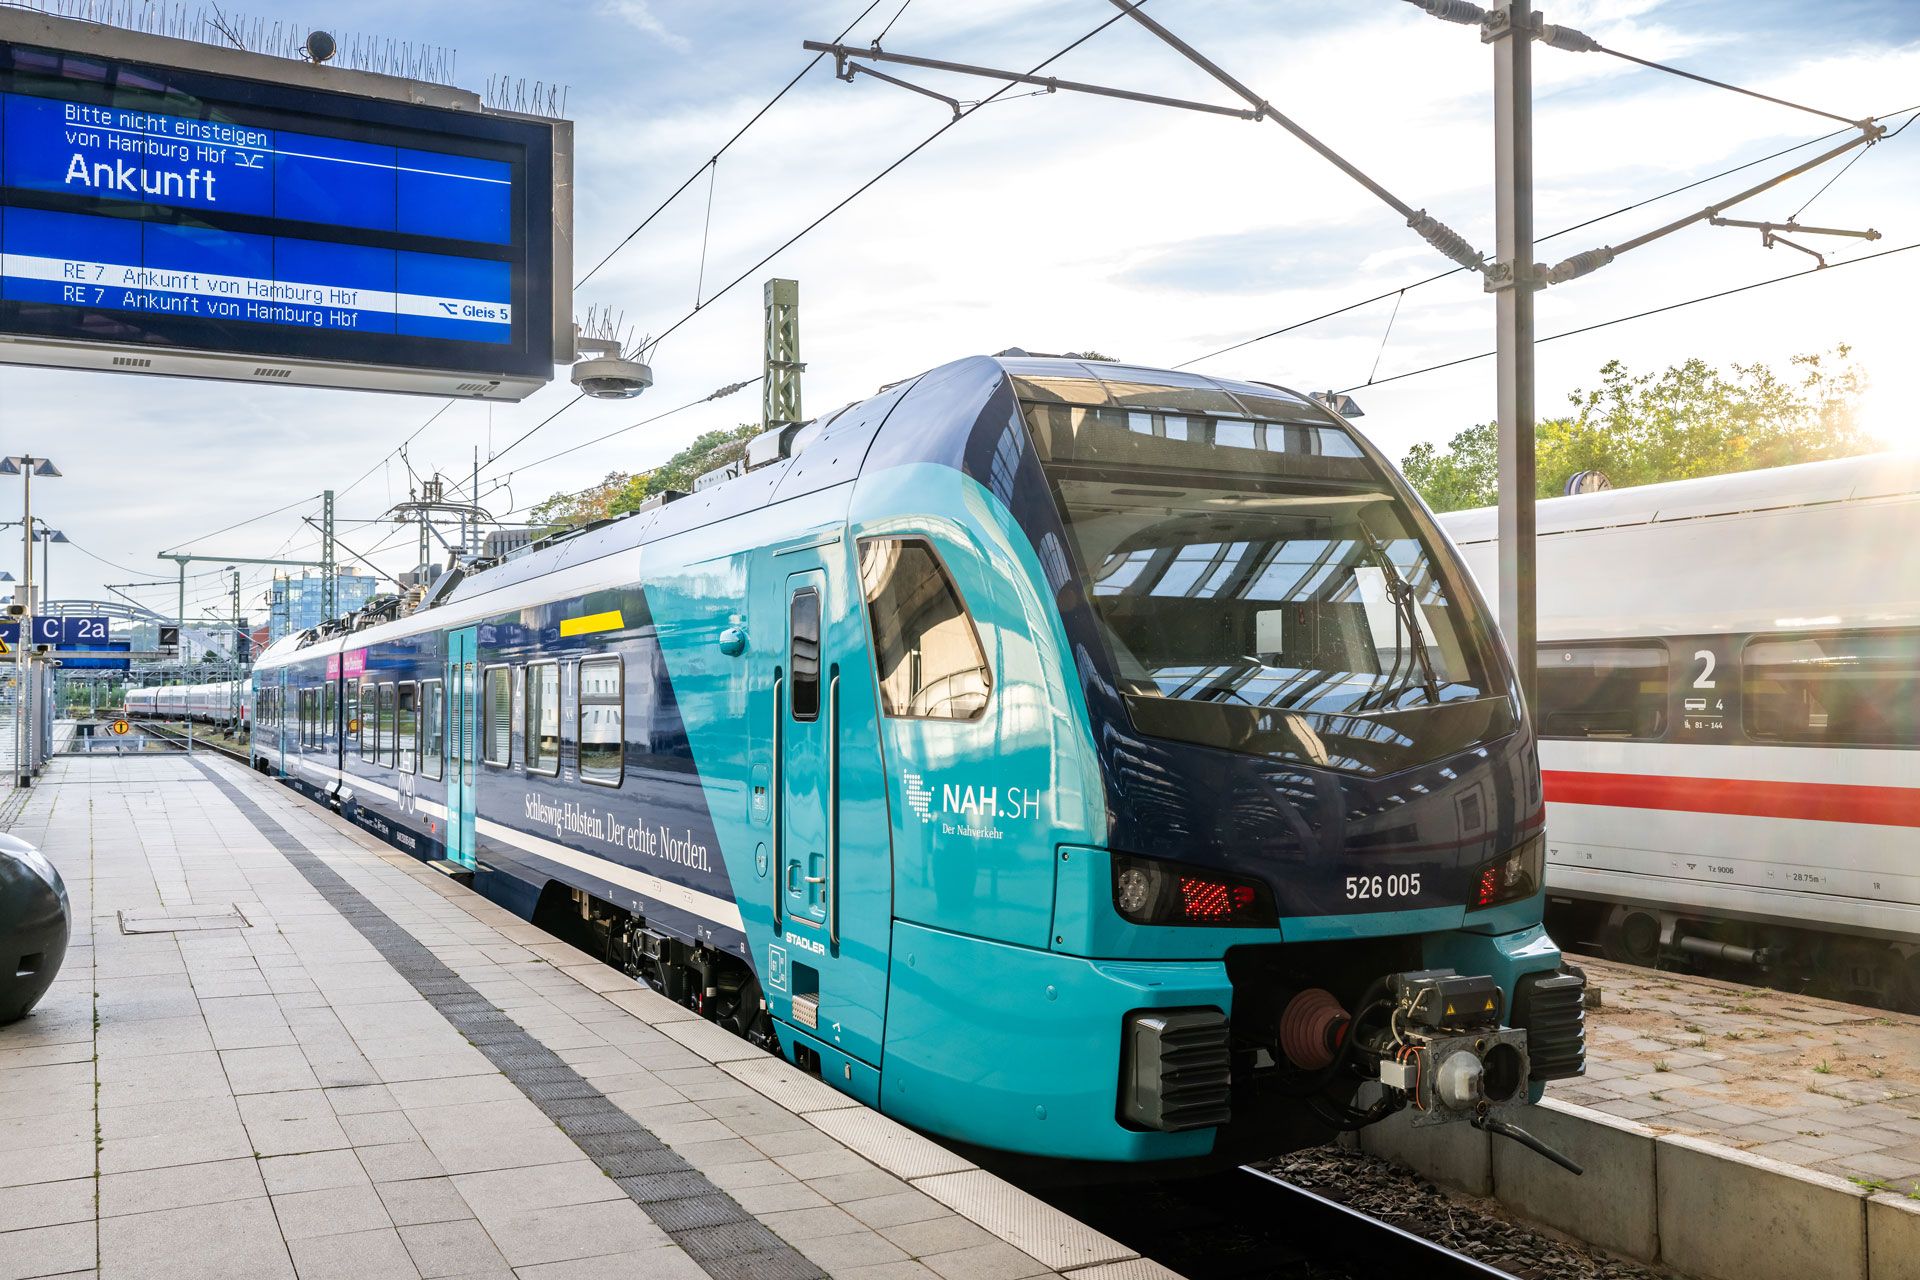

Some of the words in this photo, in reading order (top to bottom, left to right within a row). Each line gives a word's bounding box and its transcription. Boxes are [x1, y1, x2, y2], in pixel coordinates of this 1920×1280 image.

[65, 103, 112, 124] Bitte
[119, 112, 167, 133] nicht
[175, 119, 267, 147] einsteigen
[65, 130, 100, 148] von
[108, 134, 189, 162] Hamburg
[197, 146, 226, 164] Hbf
[65, 153, 216, 201] Ankunft
[64, 262, 86, 279] RE
[94, 265, 105, 281] 7
[123, 268, 199, 291] Ankunft
[207, 278, 240, 294] von
[247, 281, 323, 304] Hamburg
[330, 289, 358, 306] Hbf
[64, 285, 86, 303] RE
[94, 288, 105, 304] 7
[123, 290, 199, 313] Ankunft
[207, 300, 240, 316] von
[247, 303, 323, 327] Hamburg
[330, 311, 358, 328] Hbf
[462, 304, 496, 319] Gleis
[500, 308, 509, 320] 5
[43, 619, 59, 638] C
[78, 619, 106, 638] 2a
[515, 665, 522, 697] 2
[567, 659, 573, 697] 1
[1693, 649, 1716, 689] 2
[1715, 698, 1724, 710] 4
[1694, 721, 1703, 729] 81
[943, 783, 1040, 820] NAH.SH
[525, 793, 605, 841] Schleswig-Holstein.
[606, 813, 625, 847] Der
[627, 818, 657, 857] echte
[660, 826, 712, 873] Norden.
[942, 823, 955, 835] Der
[957, 825, 1003, 840] Nahverkehr
[1346, 875, 1382, 900] 526
[1387, 873, 1421, 897] 005
[1717, 866, 1734, 875] 9006
[786, 932, 825, 956] STADLER
